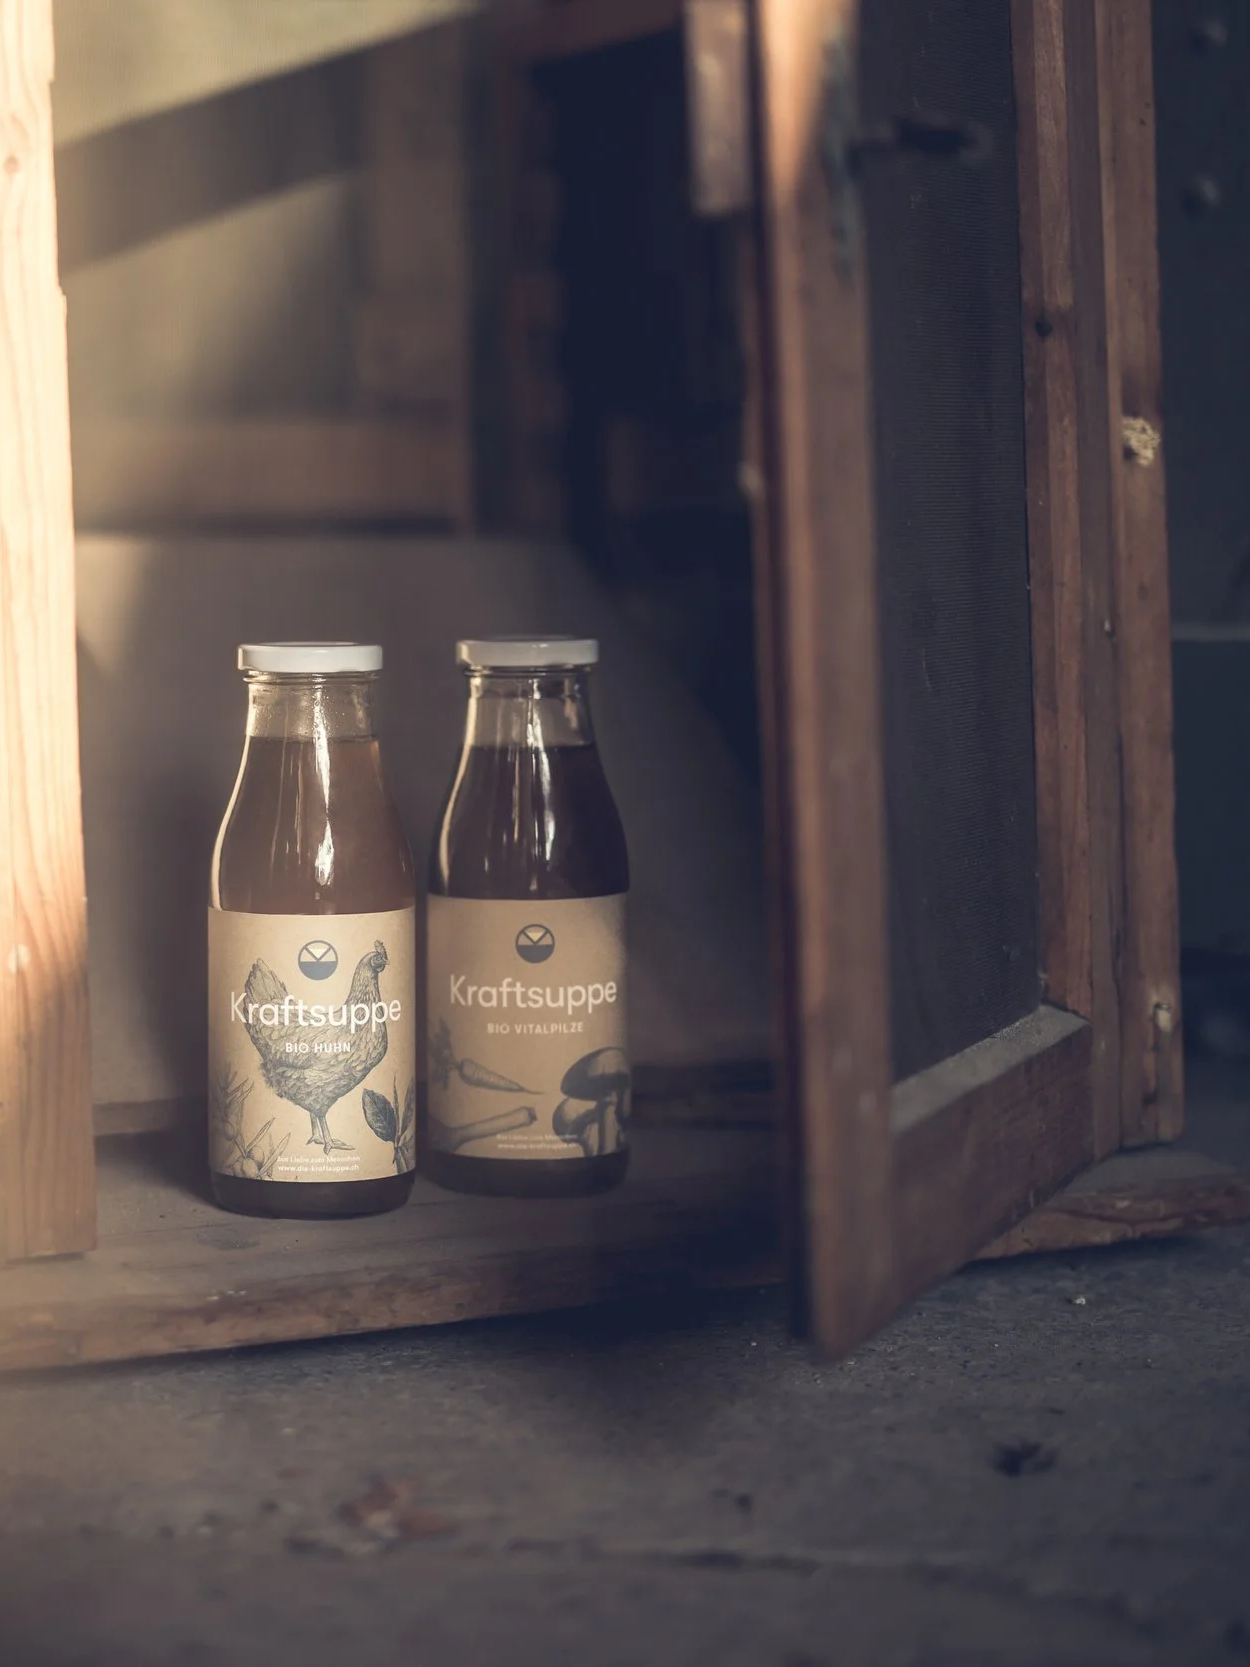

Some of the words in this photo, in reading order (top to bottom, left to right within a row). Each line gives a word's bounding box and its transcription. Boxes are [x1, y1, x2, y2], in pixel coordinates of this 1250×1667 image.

[450, 973, 618, 1015] Kraftsuppe
[230, 991, 402, 1034] Kraftsuppe
[486, 1022, 510, 1034] BIO
[514, 1021, 584, 1034] VITALPILZE
[285, 1042, 309, 1054] BIO
[314, 1042, 351, 1053] HUHN
